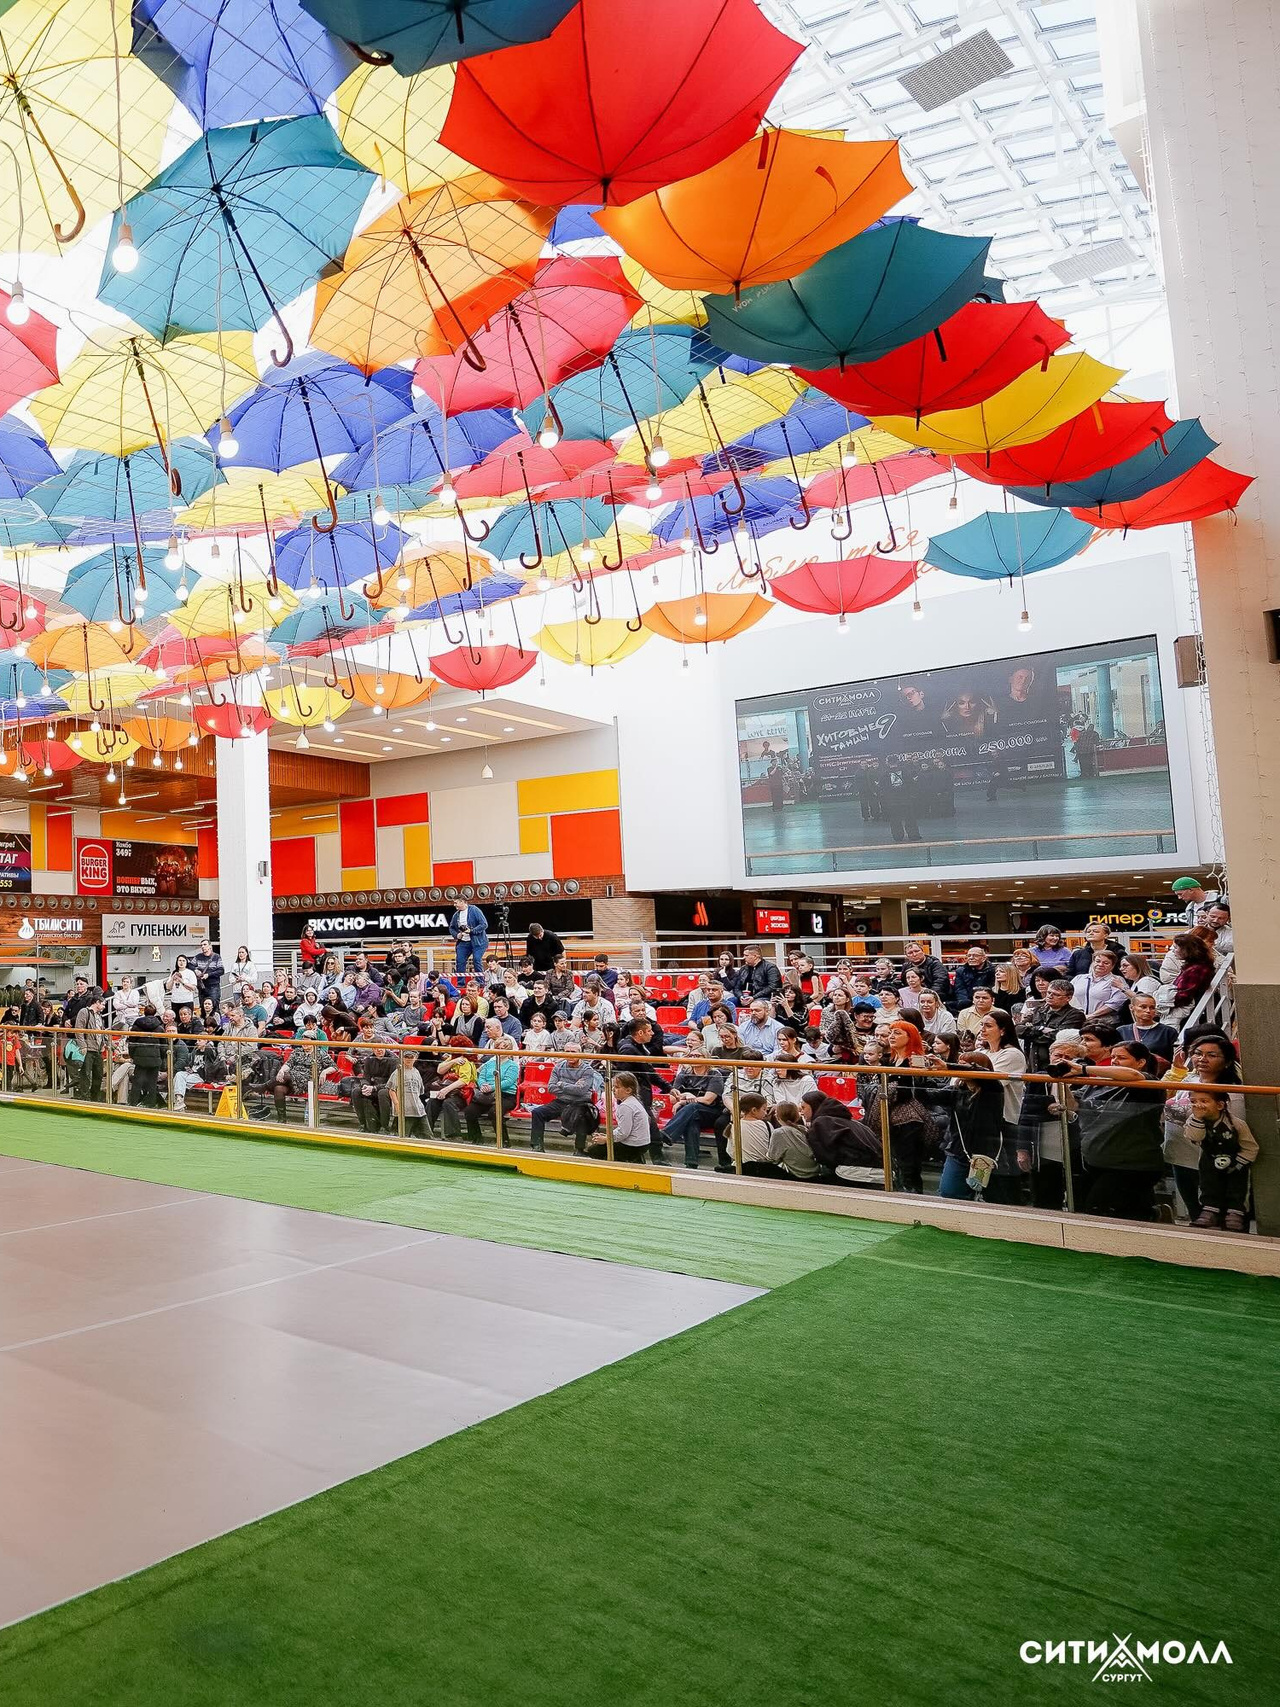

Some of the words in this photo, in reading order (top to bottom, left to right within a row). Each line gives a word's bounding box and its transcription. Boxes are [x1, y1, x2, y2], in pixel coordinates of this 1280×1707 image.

[81, 858, 107, 867] BURGER
[81, 867, 108, 879] KING
[130, 886, 156, 894] ВКУСНО
[34, 918, 83, 932] ТБИЛИСИТИ
[393, 913, 449, 929] ТОЧКА
[1089, 913, 1145, 926] гипер
[130, 924, 187, 937] ГУЛЕНЬКИ
